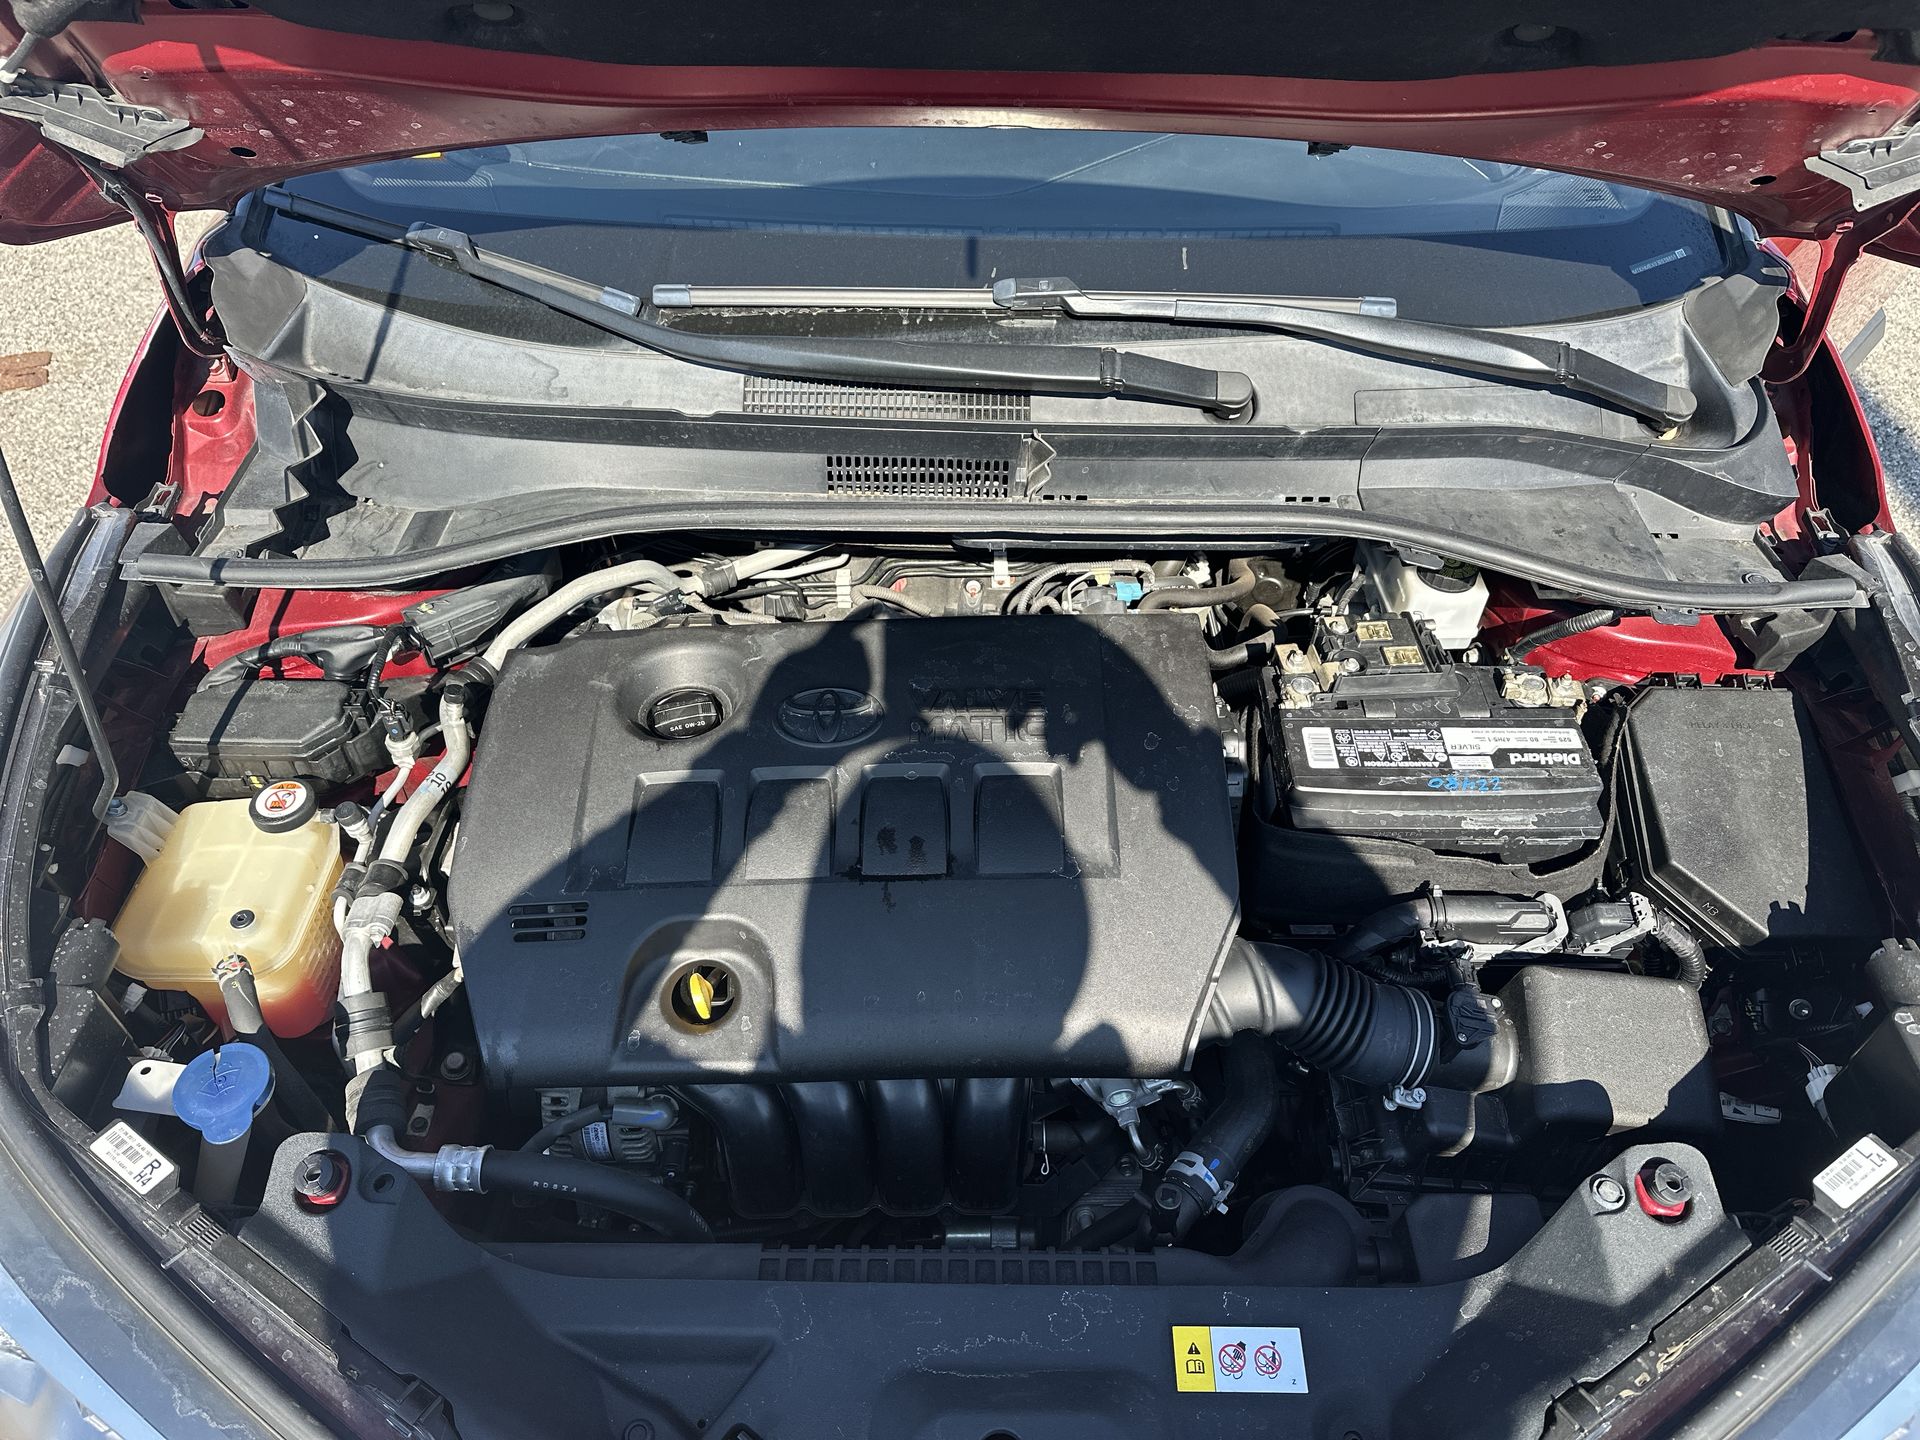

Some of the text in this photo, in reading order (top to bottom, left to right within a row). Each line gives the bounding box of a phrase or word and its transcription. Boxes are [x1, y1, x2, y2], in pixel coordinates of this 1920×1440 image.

[684, 720, 706, 728] 0W-20
[908, 715, 1047, 743] MATIC
[1509, 752, 1581, 766] DieHard
[430, 771, 447, 788] 10
[1427, 774, 1503, 792] 22480
[1701, 902, 1719, 916] M3
[1855, 1148, 1873, 1159] L
[1869, 1152, 1887, 1168] L4
[142, 1158, 162, 1176] R
[132, 1170, 153, 1187] H4
